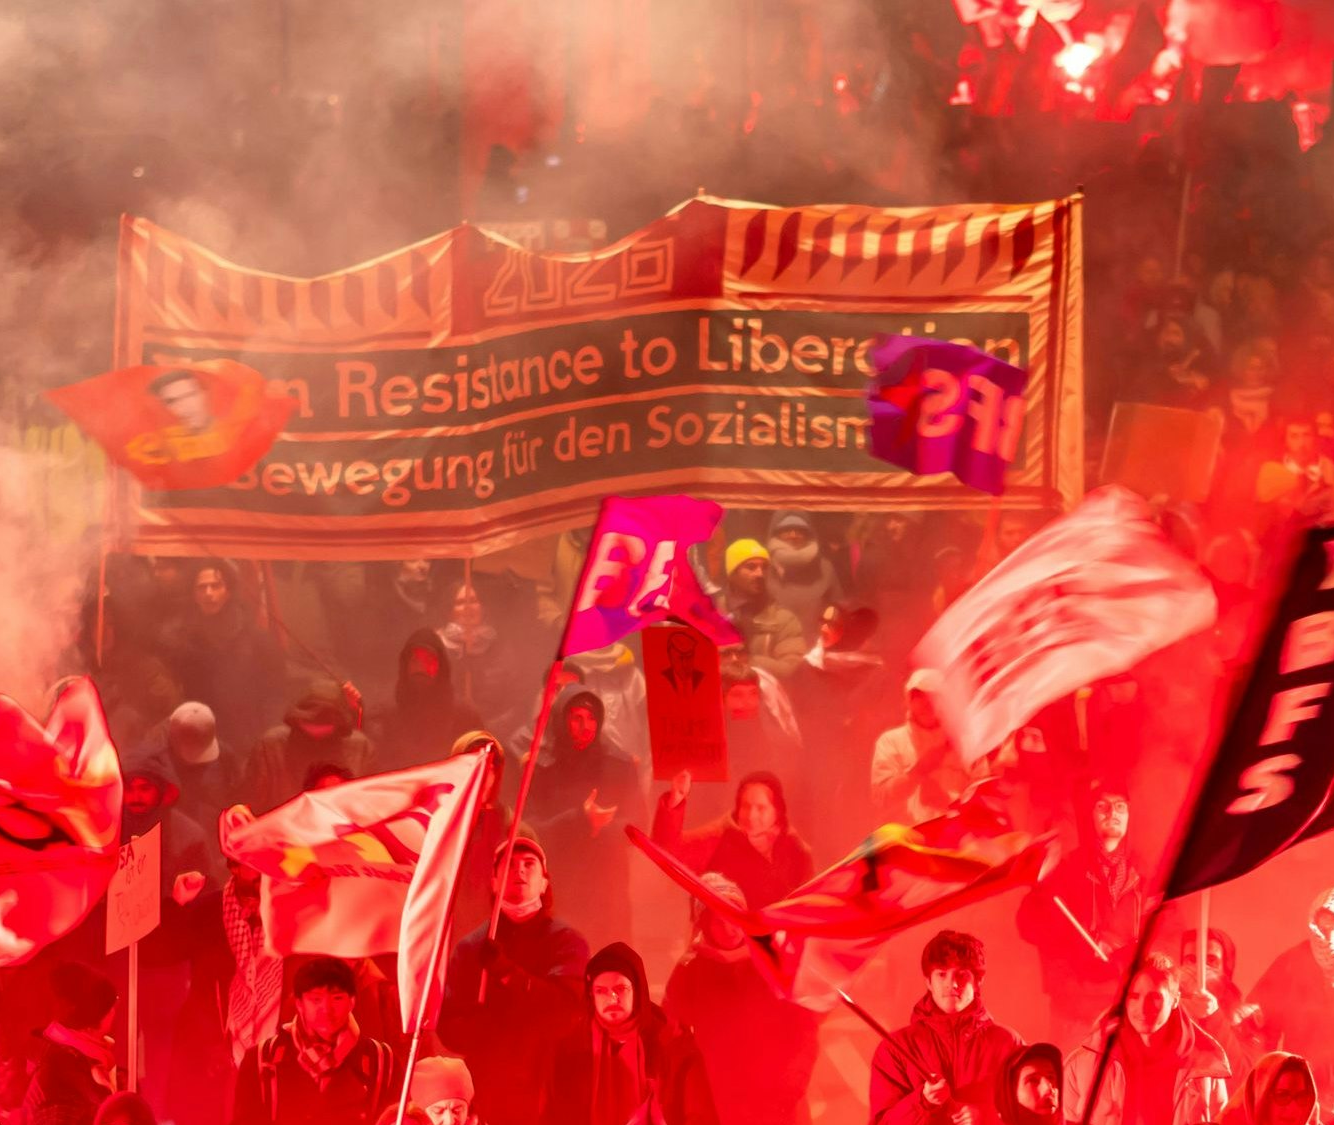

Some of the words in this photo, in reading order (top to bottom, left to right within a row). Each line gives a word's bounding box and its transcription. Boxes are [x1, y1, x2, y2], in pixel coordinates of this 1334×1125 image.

[335, 345, 603, 418] Resistance
[620, 329, 677, 379] to
[503, 431, 543, 479] für
[553, 416, 632, 463] den
